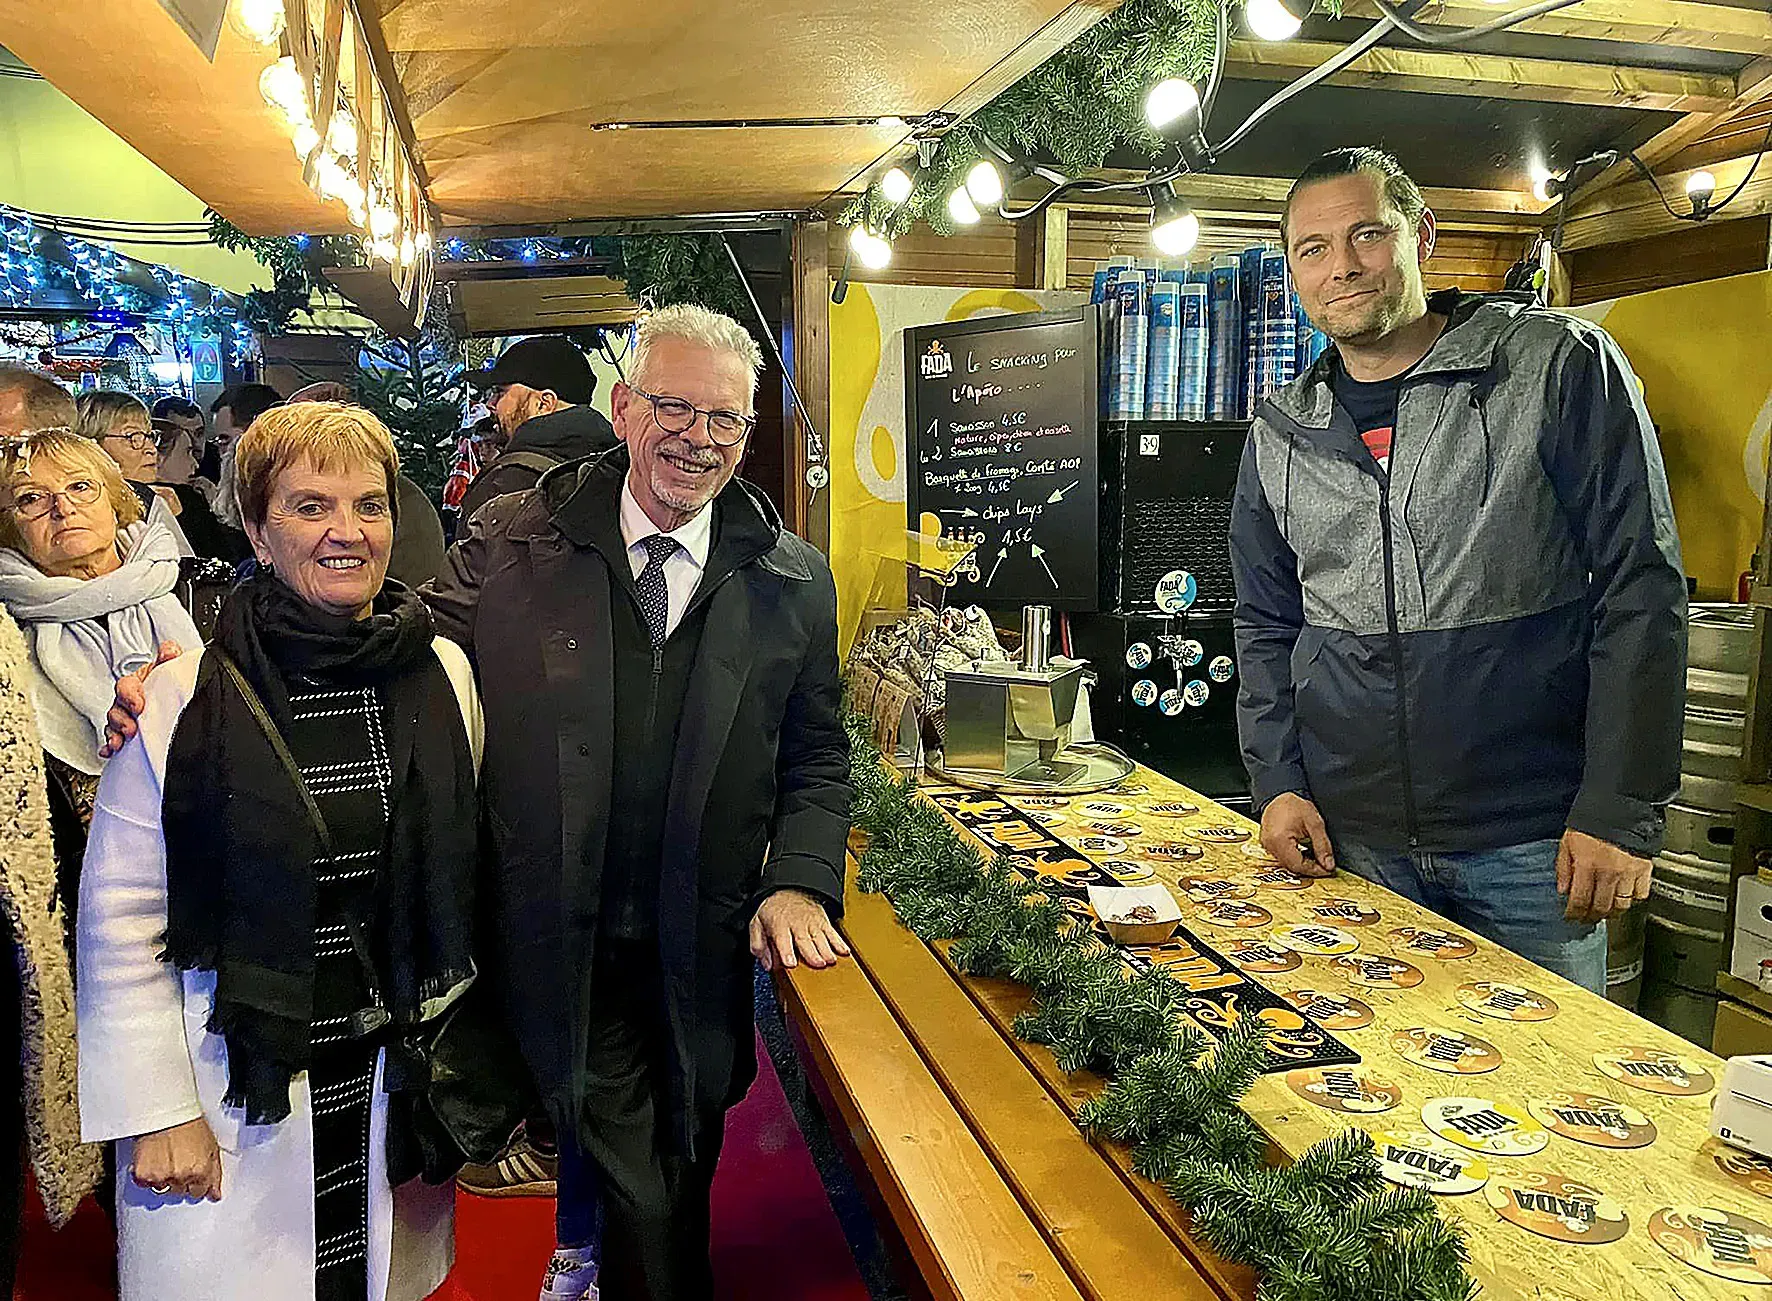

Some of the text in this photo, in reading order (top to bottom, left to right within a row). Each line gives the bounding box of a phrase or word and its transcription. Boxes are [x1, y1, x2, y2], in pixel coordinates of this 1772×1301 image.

[920, 352, 953, 375] FADA
[923, 418, 938, 438] 1
[1444, 1109, 1518, 1136] FADA
[1387, 1145, 1462, 1180] FADA
[1513, 1189, 1596, 1225] FADA
